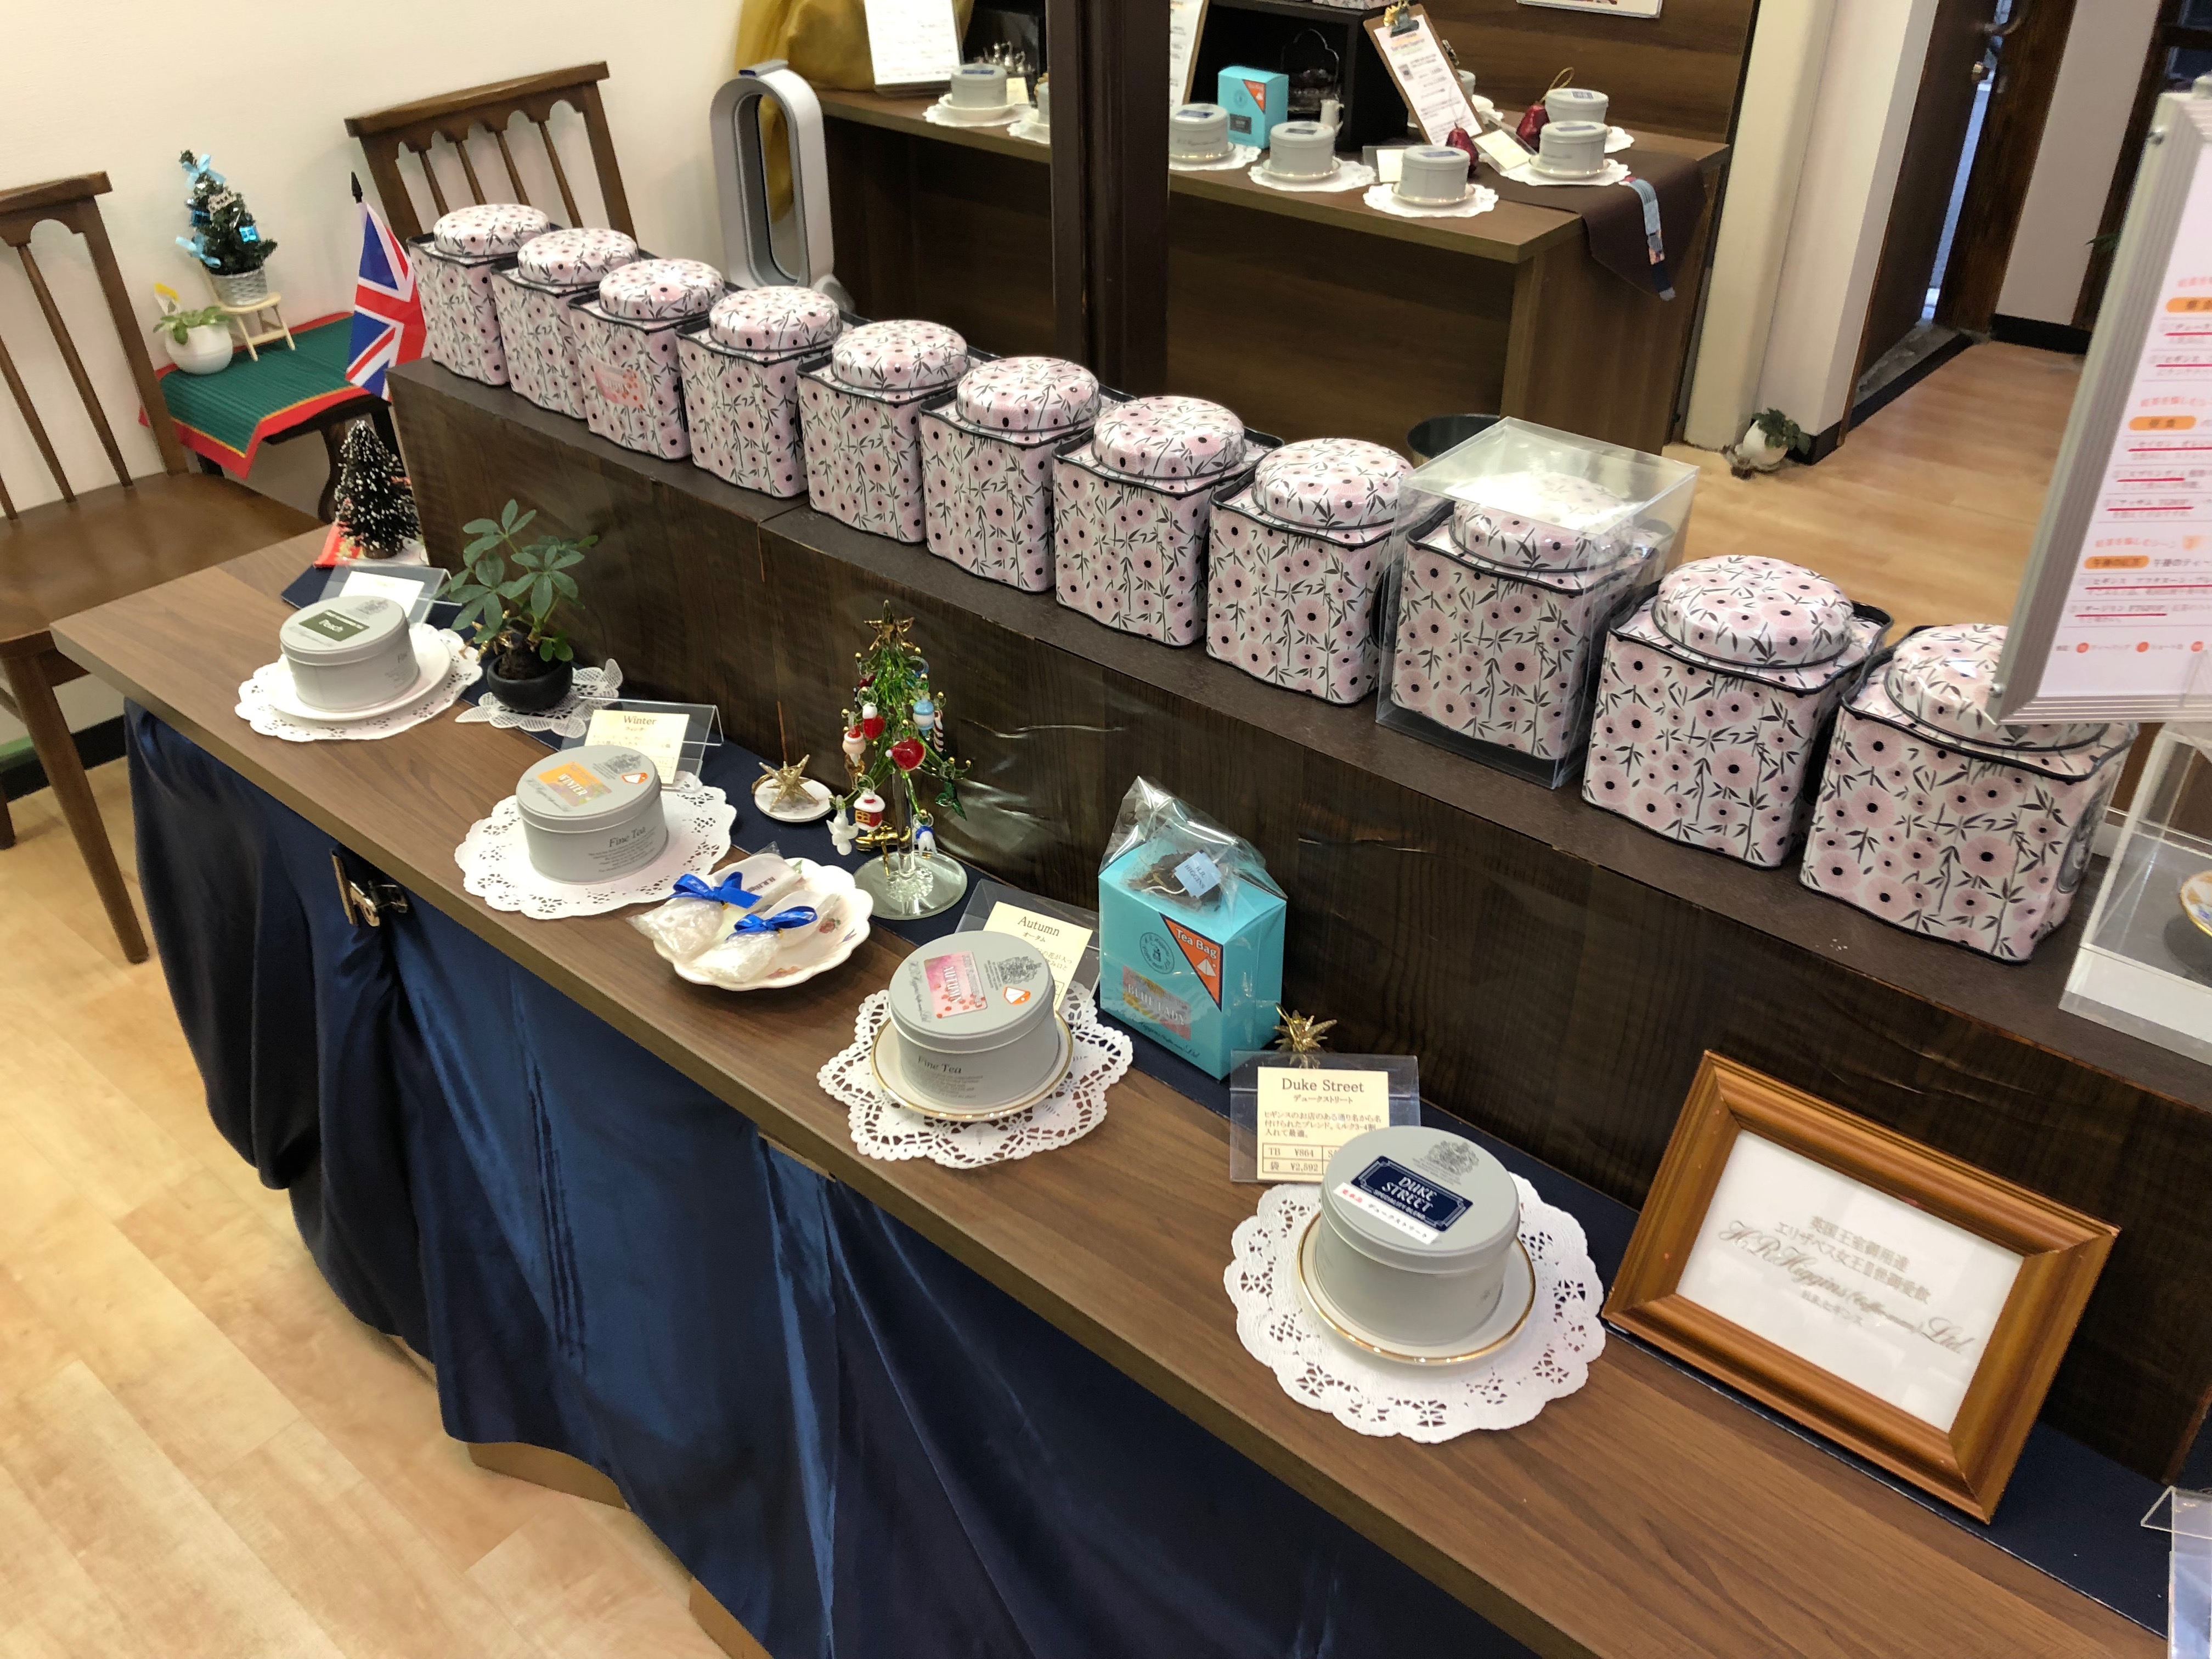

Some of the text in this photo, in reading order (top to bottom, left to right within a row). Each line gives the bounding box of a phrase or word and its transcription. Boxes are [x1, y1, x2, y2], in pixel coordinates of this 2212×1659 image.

[624, 715, 657, 725] Winter
[557, 772, 588, 797] WINTER
[1184, 864, 1206, 889] HIGGINS
[1018, 916, 1060, 937] Autumn
[1176, 928, 1217, 960] Tea Bag
[943, 966, 962, 1003] AUTUMN
[1158, 1002, 1185, 1026] LADY
[940, 1061, 962, 1075] Tea
[1282, 1077, 1365, 1093] Duke Street
[1381, 1182, 1434, 1212] STREET
[1398, 1176, 1437, 1201] DUKE
